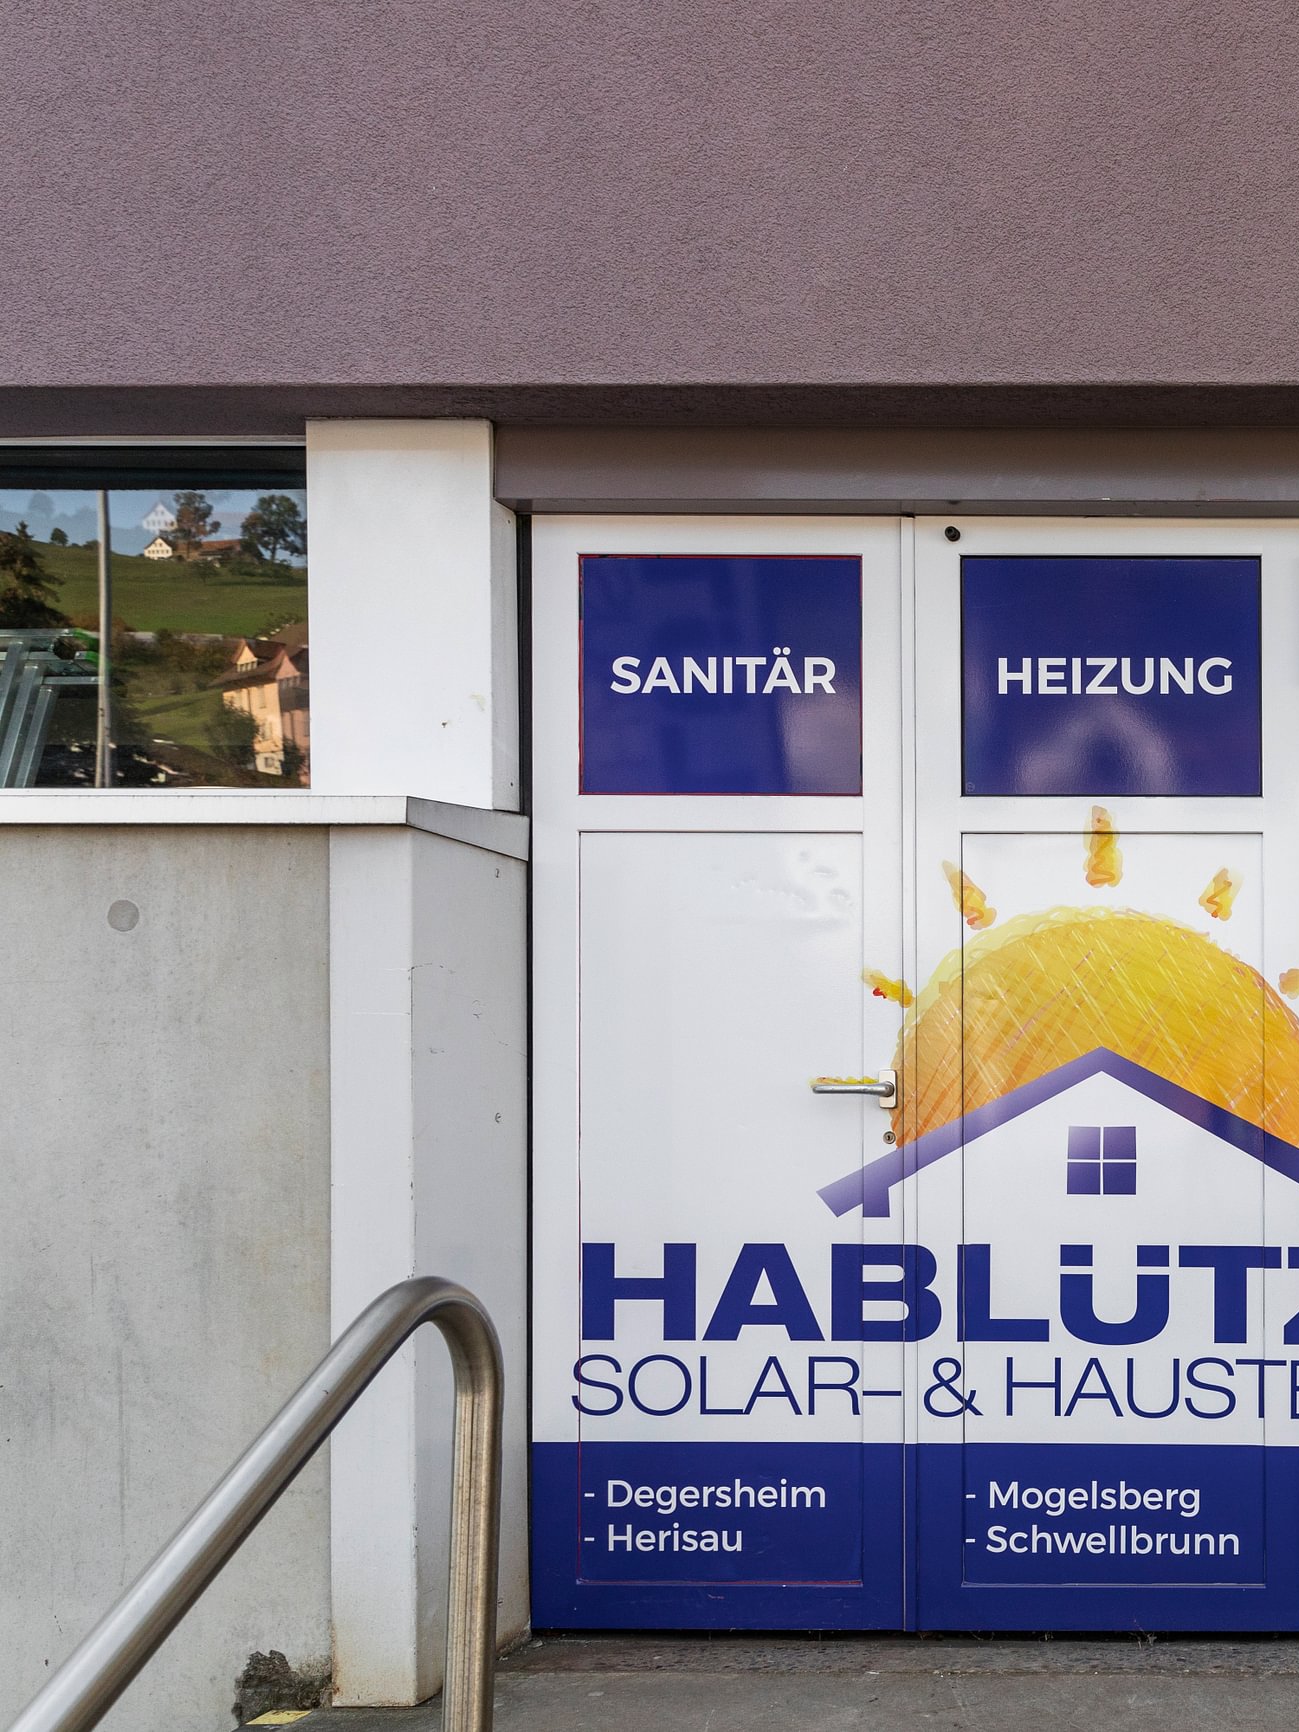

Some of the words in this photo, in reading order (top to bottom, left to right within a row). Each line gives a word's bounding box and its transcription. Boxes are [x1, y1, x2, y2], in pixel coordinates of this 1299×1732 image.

[610, 646, 836, 694] SANITÄR
[998, 657, 1232, 695] HEIZUNG
[571, 1353, 903, 1417] SOLAR-
[923, 1356, 985, 1418] &
[607, 1478, 826, 1515] Degersheim
[989, 1480, 1200, 1518] Mogelsberg
[608, 1522, 742, 1552] Herisau
[986, 1524, 1239, 1555] Schwellbrunn
